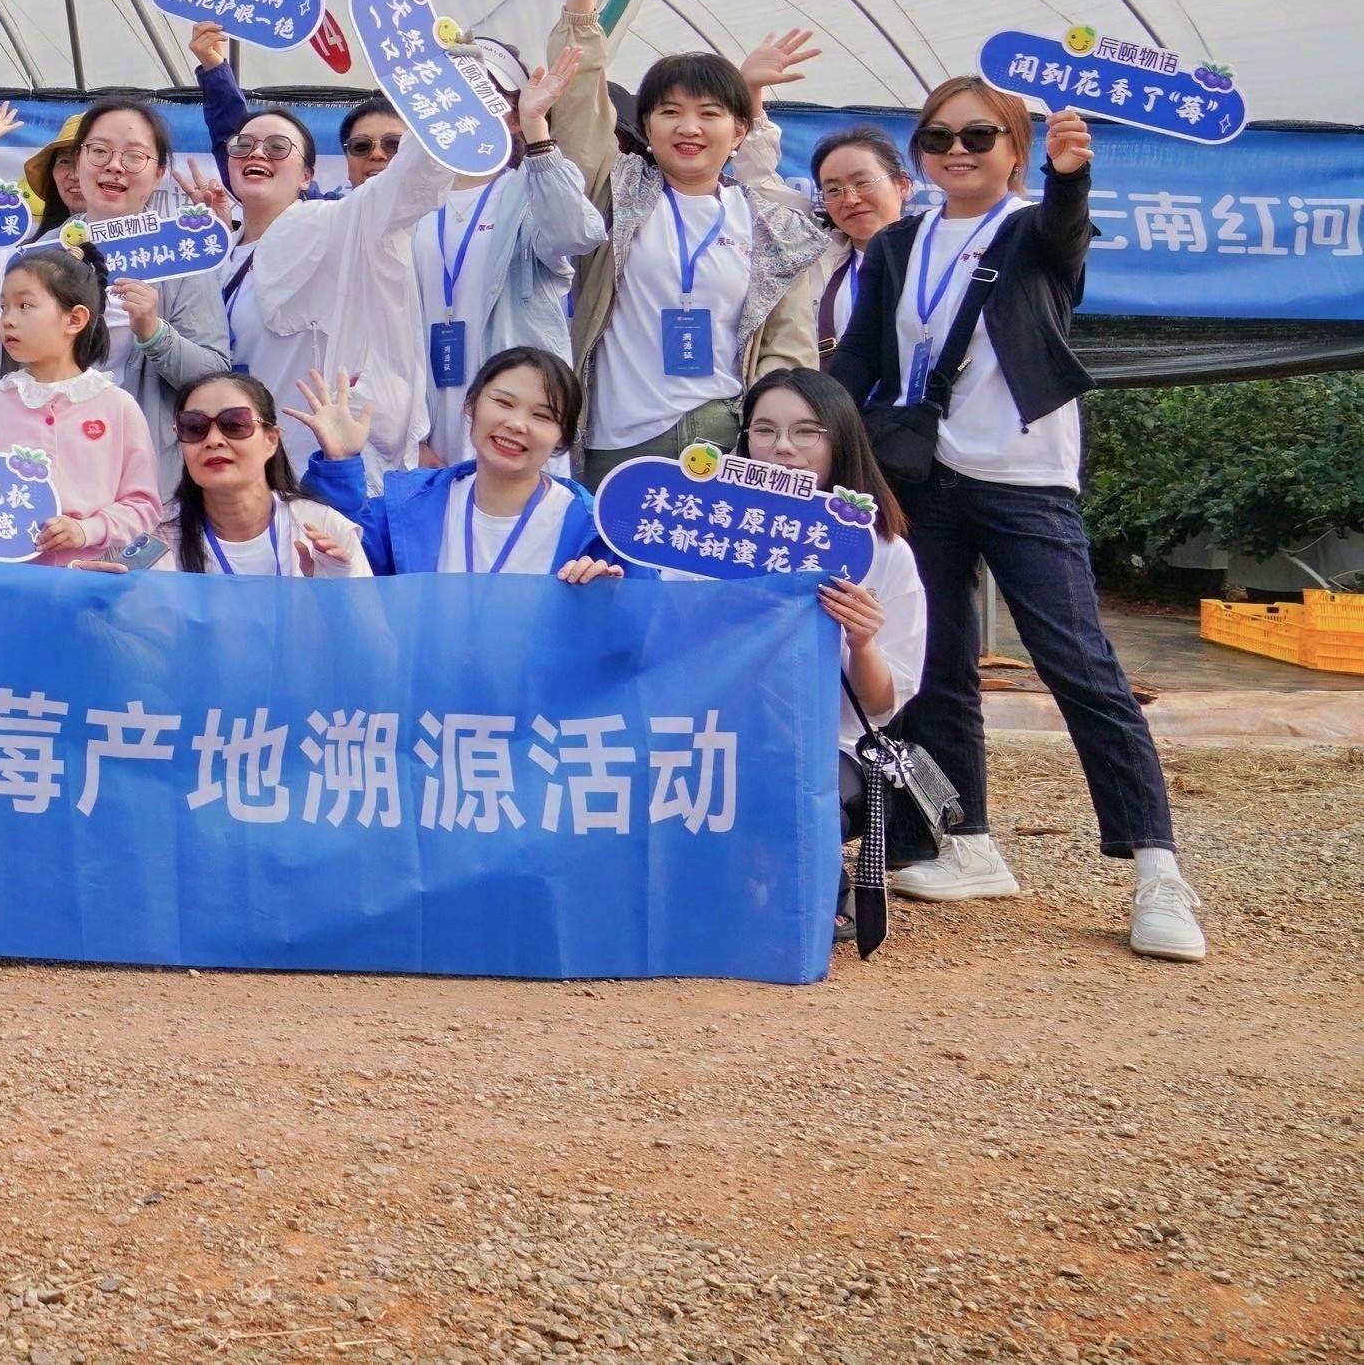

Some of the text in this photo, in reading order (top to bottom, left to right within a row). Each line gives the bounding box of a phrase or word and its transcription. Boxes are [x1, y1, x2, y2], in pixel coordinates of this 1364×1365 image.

[1097, 36, 1180, 74] 辰颐物语
[90, 213, 160, 242] 辰颐物语
[721, 457, 816, 498] 辰颐物语
[640, 486, 832, 552] 沐浴高原阳光
